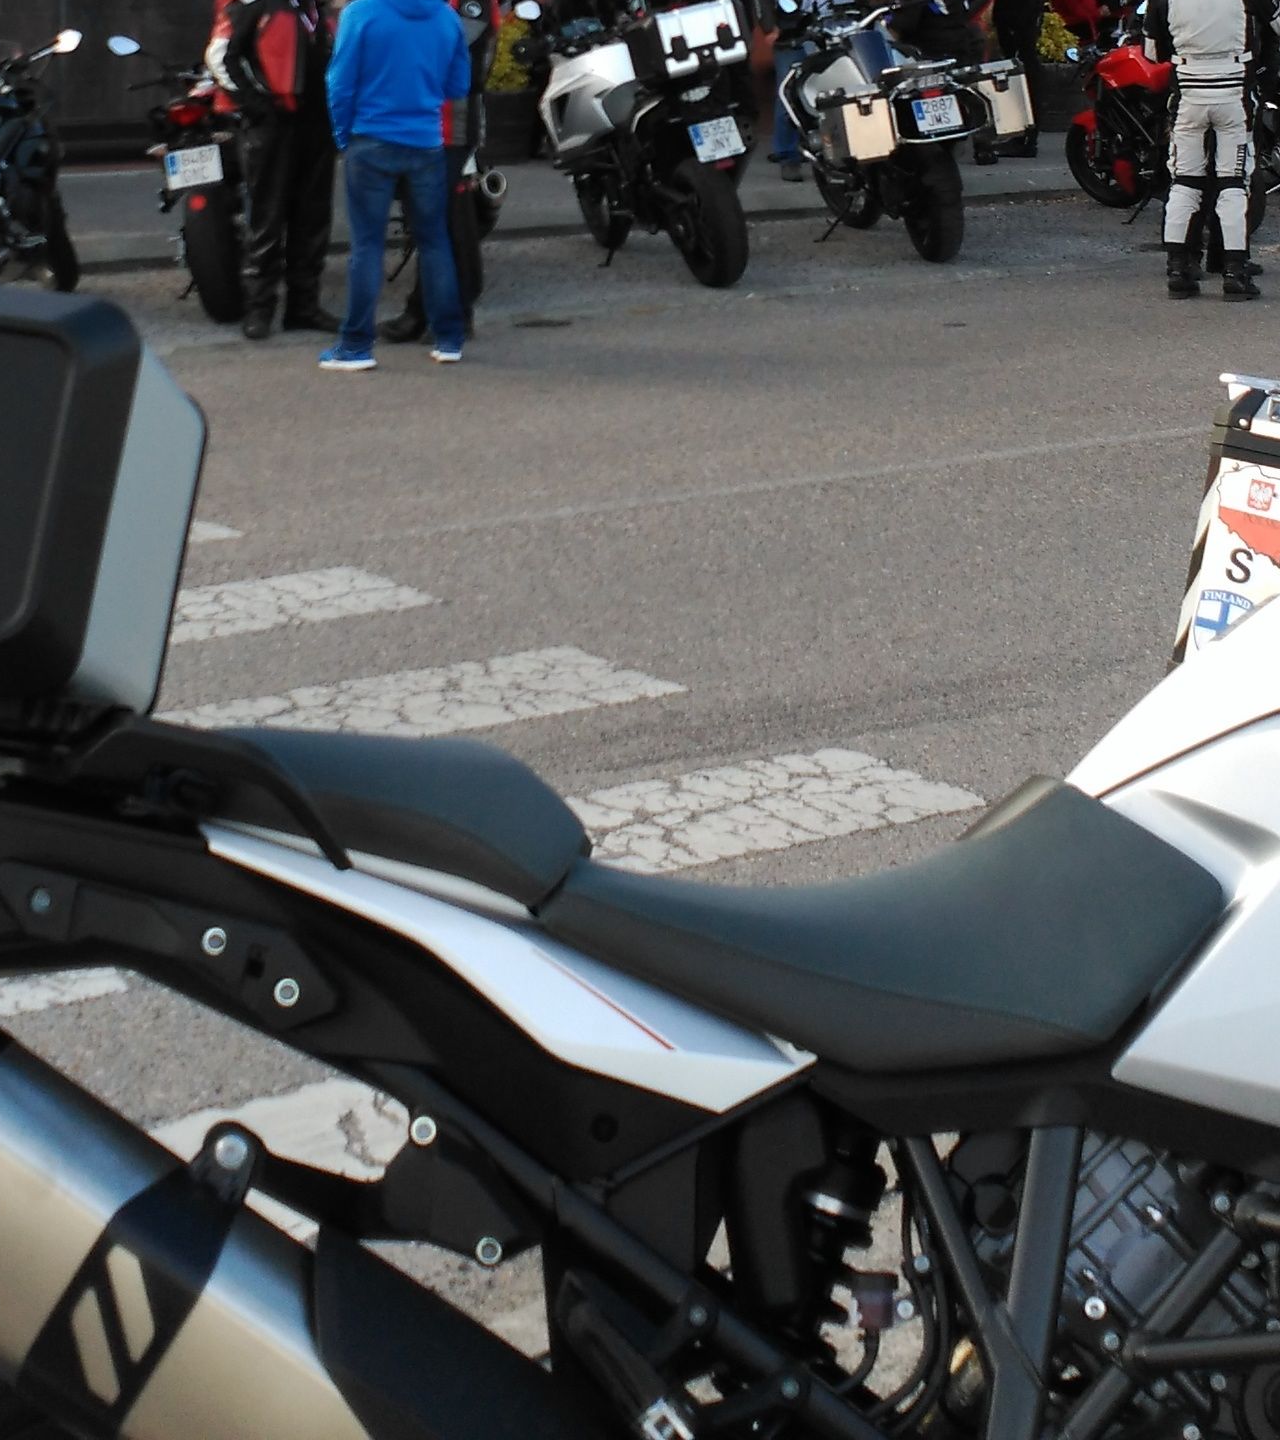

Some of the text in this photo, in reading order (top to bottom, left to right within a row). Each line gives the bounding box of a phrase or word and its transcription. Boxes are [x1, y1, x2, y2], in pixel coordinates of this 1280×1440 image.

[923, 97, 953, 113] 2887
[929, 112, 951, 126] JMS
[1225, 548, 1254, 584] S
[1203, 591, 1251, 610] FINLAND
